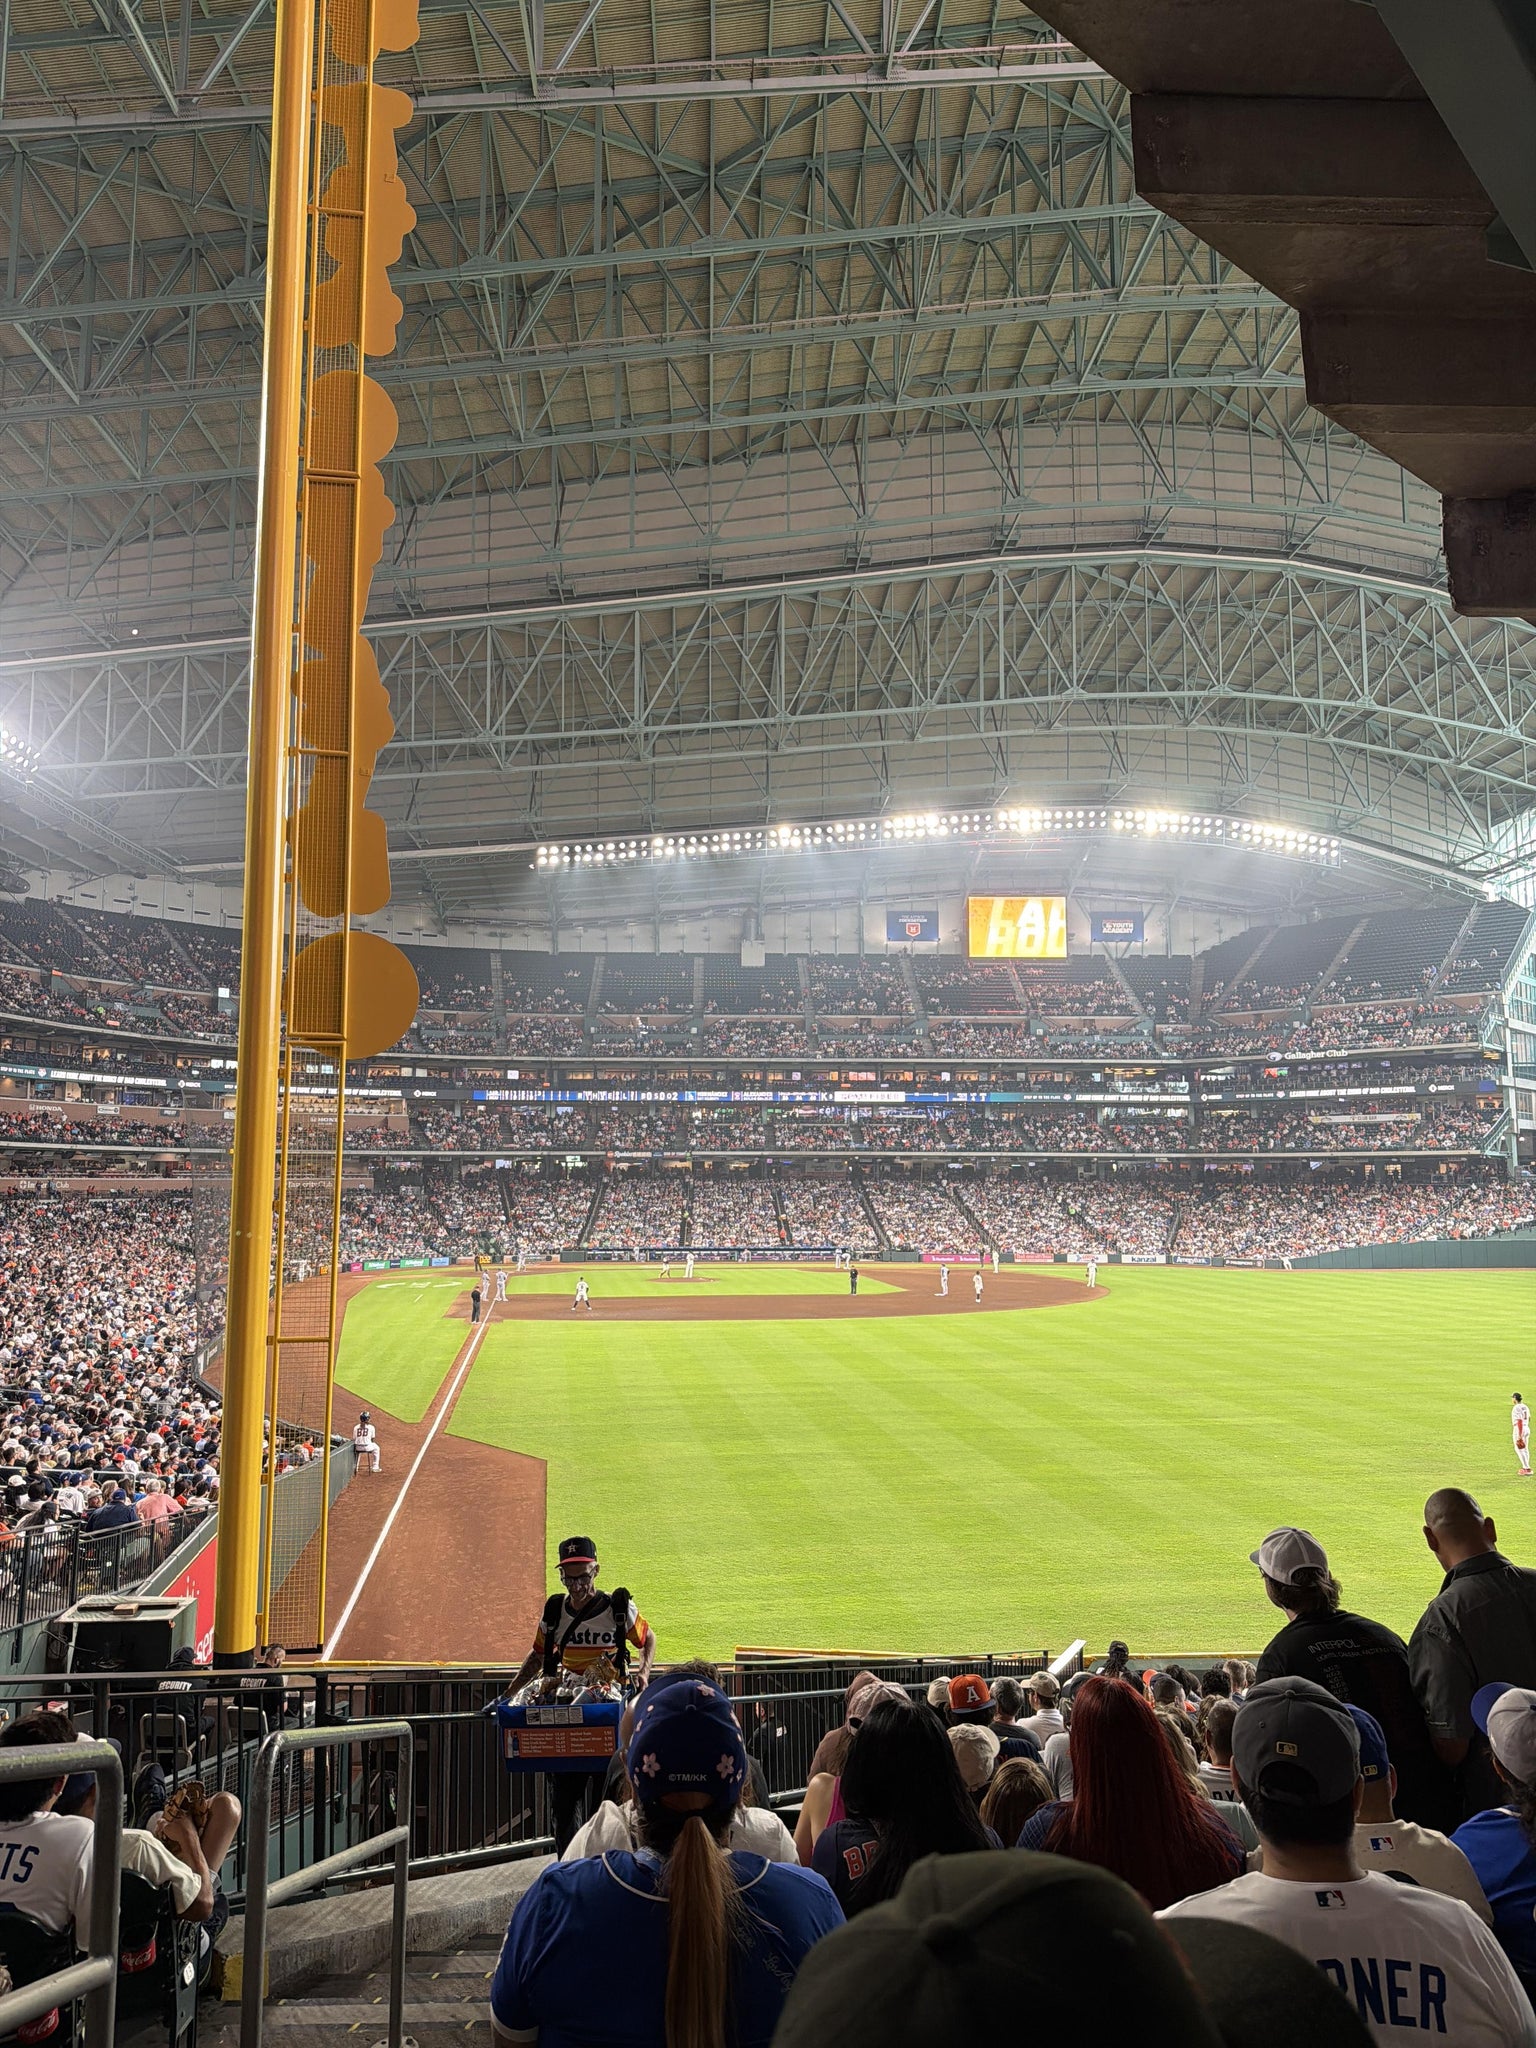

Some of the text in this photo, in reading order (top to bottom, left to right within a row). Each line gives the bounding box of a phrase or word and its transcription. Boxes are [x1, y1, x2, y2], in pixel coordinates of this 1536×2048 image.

[1284, 1050, 1326, 1061] Gallagher
[1325, 1049, 1349, 1058] Club
[36, 1104, 63, 1112] HONDA
[56, 1181, 70, 1189] Club
[1307, 1638, 1361, 1654] INTERPOL
[158, 1680, 193, 1691] SECURITY
[239, 1677, 268, 1688] SECURITY
[966, 1685, 981, 1703] A
[0, 1843, 41, 1884] TS
